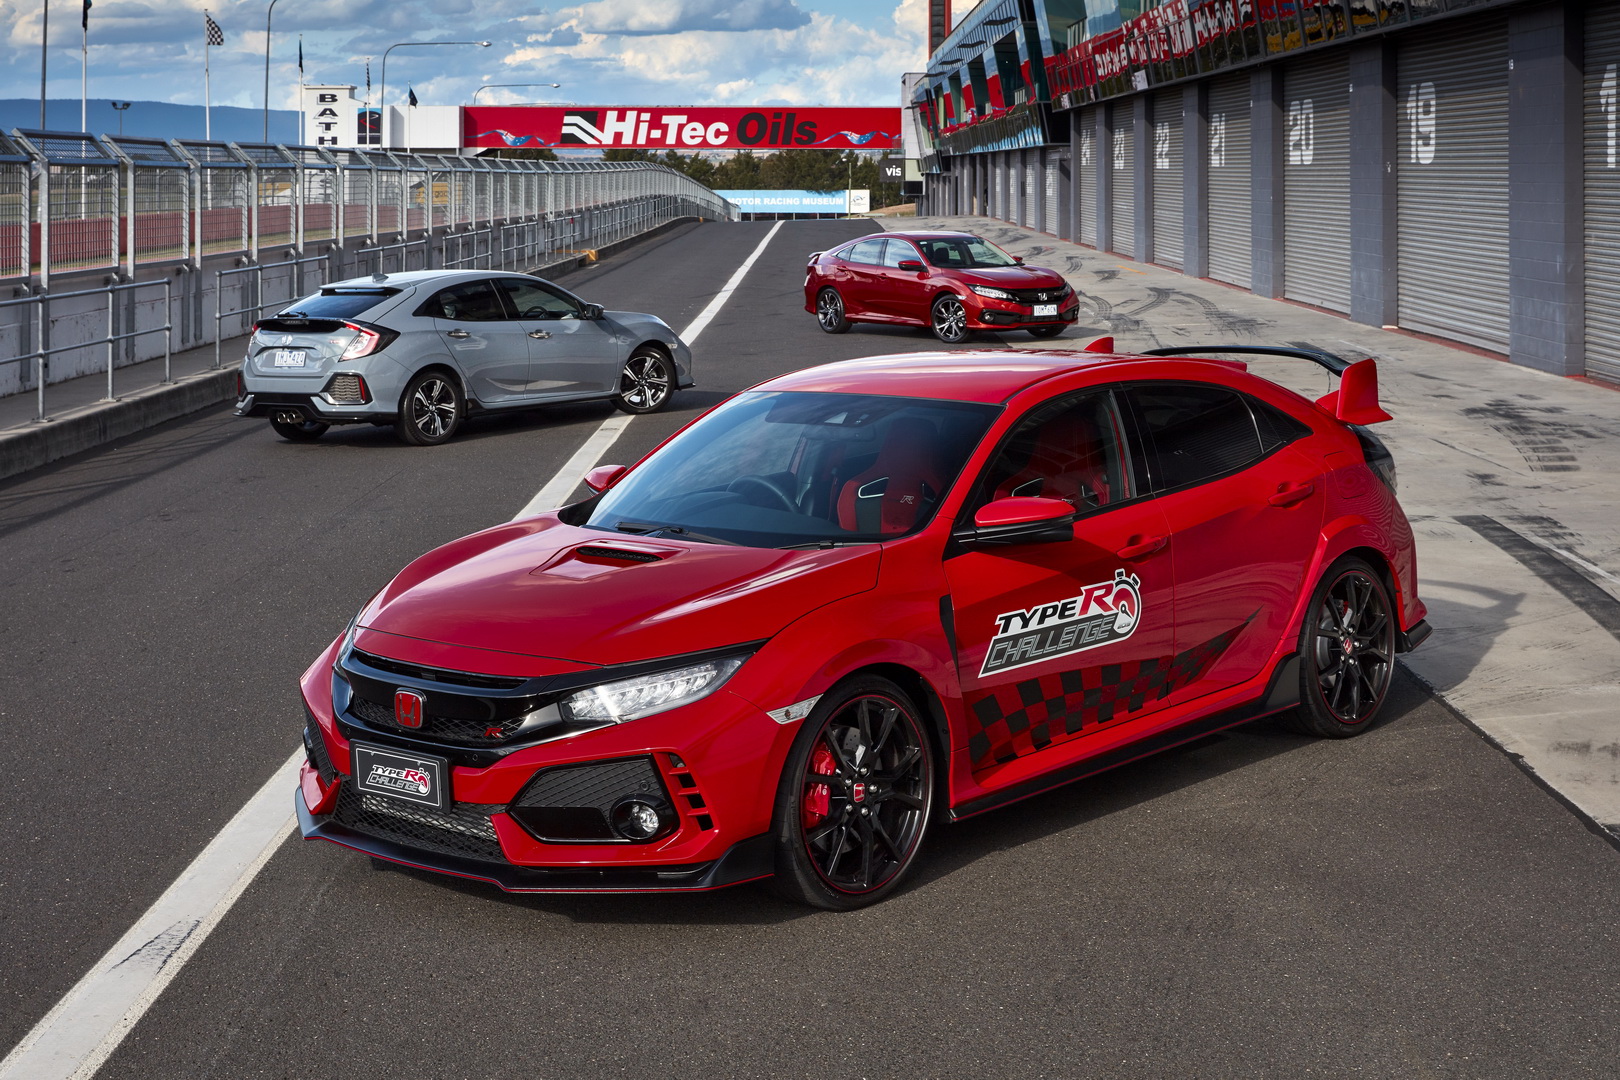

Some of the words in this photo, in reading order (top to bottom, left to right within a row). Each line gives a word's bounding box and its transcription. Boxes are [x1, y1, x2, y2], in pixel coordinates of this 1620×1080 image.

[601, 110, 729, 145] Hi-Tec
[736, 112, 817, 145] Oils
[1211, 113, 1226, 167] 21
[1289, 99, 1314, 165] 20
[1407, 82, 1436, 165] 19
[1156, 122, 1170, 169] 22
[763, 198, 800, 206] RACING
[802, 198, 844, 206] MUSEUM
[1000, 600, 1078, 635] TYPE
[987, 615, 1116, 668] CHALLENGE
[369, 774, 419, 792] CHALLENGE
[373, 764, 406, 778] TYPE
